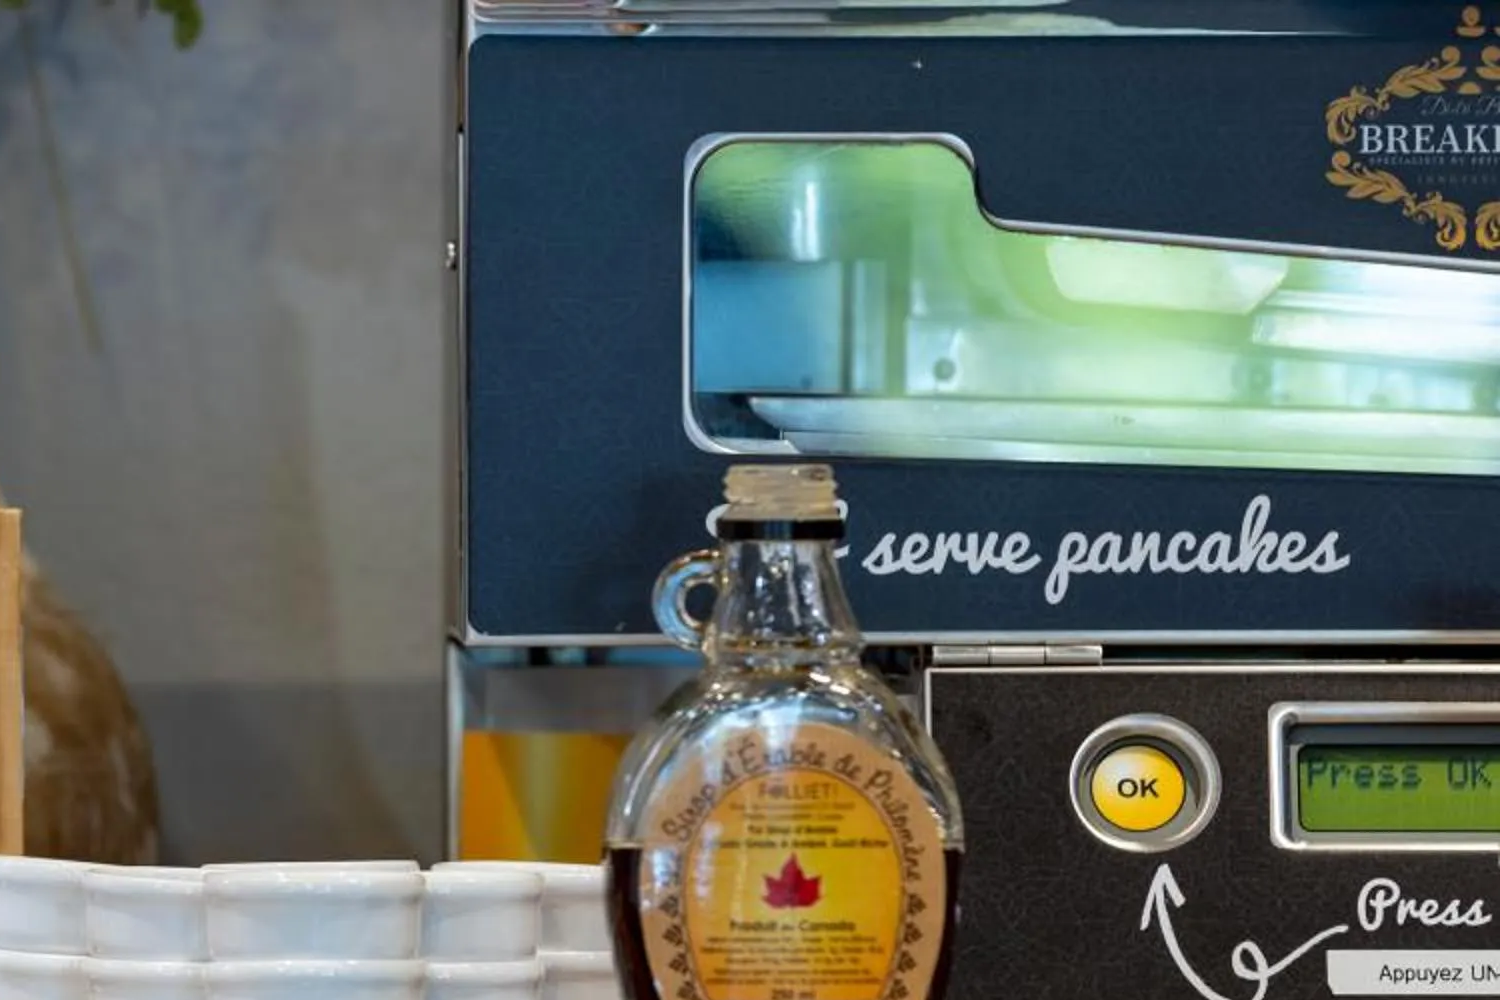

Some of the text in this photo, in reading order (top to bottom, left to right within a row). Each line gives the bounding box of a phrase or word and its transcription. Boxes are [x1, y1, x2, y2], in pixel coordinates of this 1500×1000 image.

[862, 494, 1352, 606] serve pancakes
[1117, 778, 1159, 798] OK
[1306, 757, 1493, 790] Press OK
[1356, 877, 1493, 931] Press
[1379, 963, 1463, 985] Appuyez
